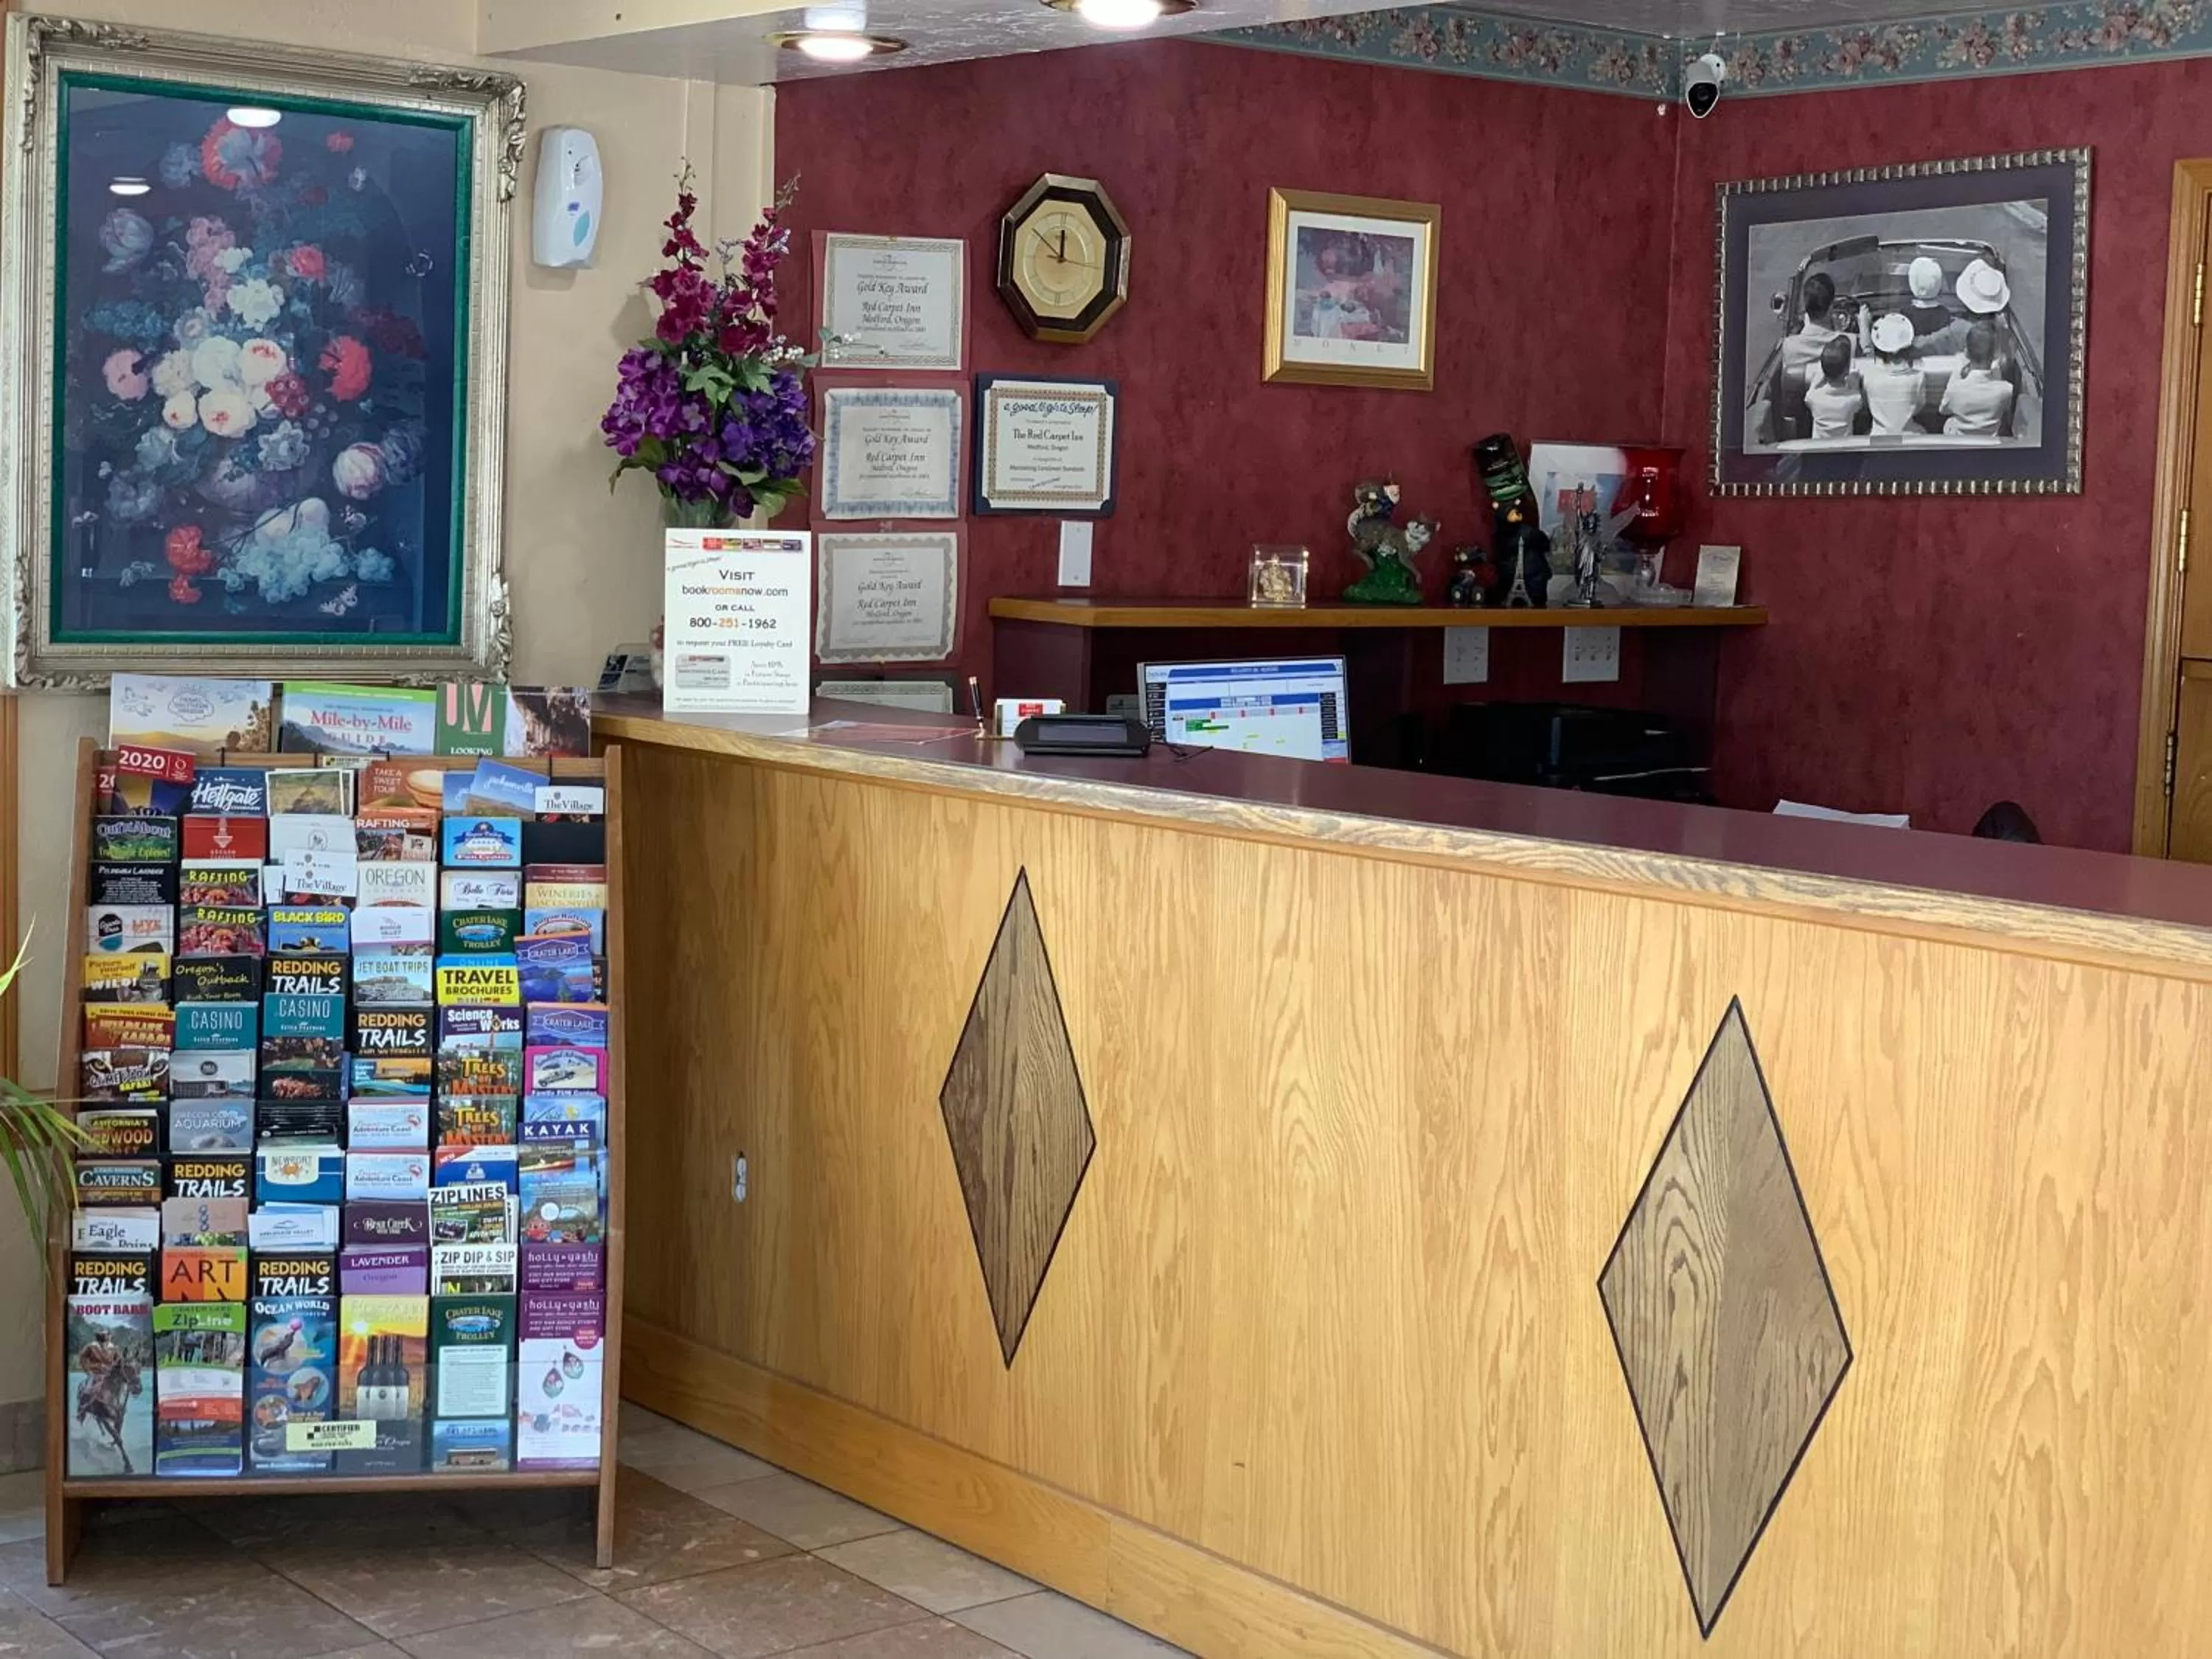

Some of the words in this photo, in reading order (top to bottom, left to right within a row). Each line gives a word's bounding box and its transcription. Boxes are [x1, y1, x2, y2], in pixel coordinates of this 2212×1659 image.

[310, 710, 414, 733] Mile-by-Mile
[118, 750, 166, 770] 2020
[191, 781, 263, 811] Hellgate
[563, 799, 594, 812] Village
[356, 818, 411, 829] RAFTING
[189, 870, 248, 883] RAFTING
[366, 867, 425, 886] OREGON
[295, 878, 312, 889] The
[313, 879, 347, 892] Village
[198, 907, 257, 923] RAFTING
[273, 910, 313, 923] BLACK
[463, 939, 501, 949] TROLLEY
[272, 961, 341, 975] REDDING
[358, 961, 374, 973] JET
[375, 961, 399, 973] BOAT
[402, 961, 429, 974] TRIPS
[197, 975, 249, 987] Outback
[443, 970, 515, 984] TRAVEL
[90, 978, 136, 991] WILD!
[271, 975, 341, 994] TRAILS
[445, 985, 512, 995] BROCHURES
[279, 998, 330, 1018] CASINO
[191, 1011, 243, 1030] CASINO
[358, 1014, 426, 1028] REDDING
[447, 1009, 494, 1022] Science
[358, 1029, 426, 1048] TRAILS
[461, 1058, 507, 1078] TREES
[173, 1118, 242, 1129] AQUARIUM
[454, 1107, 499, 1127] TREES
[524, 1123, 590, 1137] KAYAK
[271, 1155, 313, 1167] NEWPORT
[79, 1169, 154, 1187] CAVERNS
[173, 1164, 246, 1178] REDDING
[173, 1180, 246, 1198] TRAILS
[430, 1186, 506, 1204] ZIPLINES
[88, 1224, 126, 1239] Eagle
[351, 1256, 410, 1267] LAVENDER
[440, 1251, 460, 1265] ZIP
[463, 1251, 484, 1263] DIP
[484, 1251, 493, 1262] &
[495, 1250, 515, 1263] SIP
[74, 1262, 146, 1276] REDDING
[170, 1259, 238, 1284] ART
[259, 1262, 330, 1276] REDDING
[74, 1277, 146, 1295] TRAILS
[258, 1277, 330, 1295] TRAILS
[76, 1304, 111, 1315] BOOT
[254, 1301, 293, 1315] OCEAN
[294, 1300, 330, 1311] WORLD
[445, 1308, 482, 1320] CRATER
[482, 1306, 504, 1319] LAKE
[456, 1331, 495, 1340] TROLLEY
